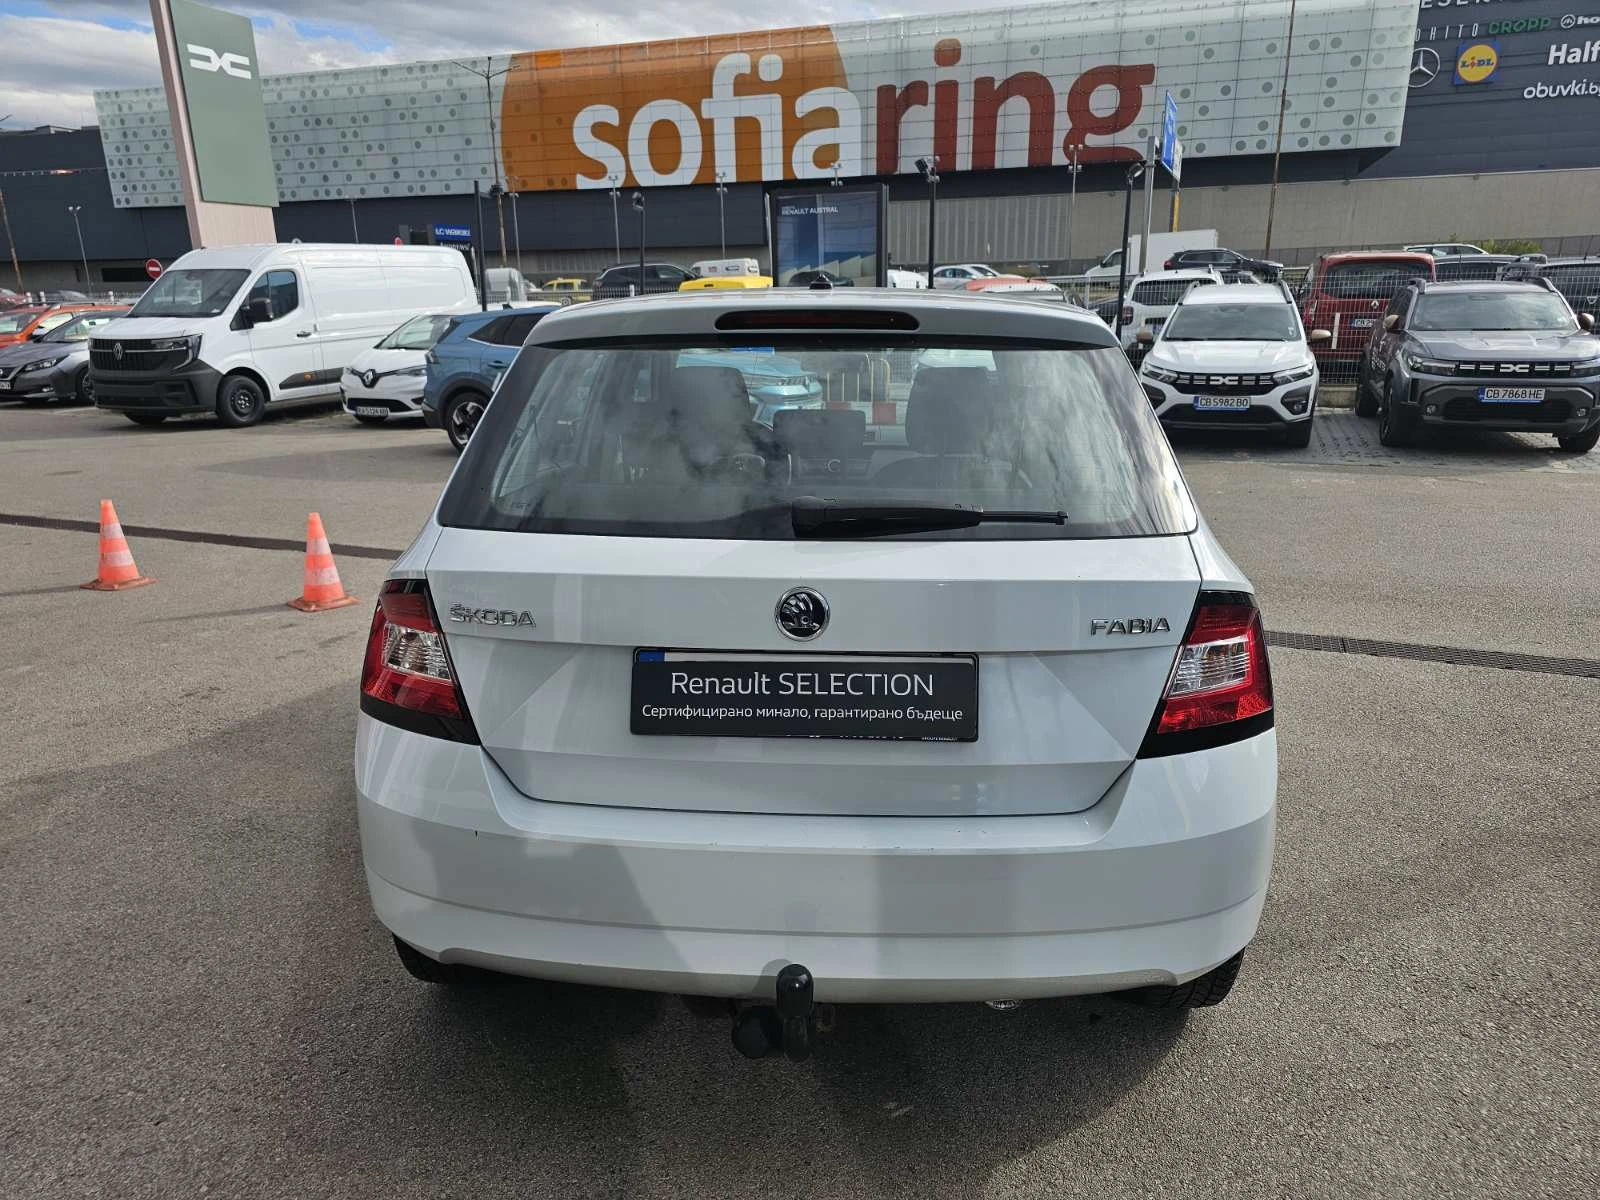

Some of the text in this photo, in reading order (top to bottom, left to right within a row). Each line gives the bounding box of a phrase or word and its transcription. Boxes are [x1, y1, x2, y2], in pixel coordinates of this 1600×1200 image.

[450, 602, 537, 628] ŠKODA
[1090, 617, 1171, 636] FABIA
[671, 671, 934, 696] Renault SELECTION
[642, 704, 964, 721] Сертифицирано минало, гарантирано бъдеще
